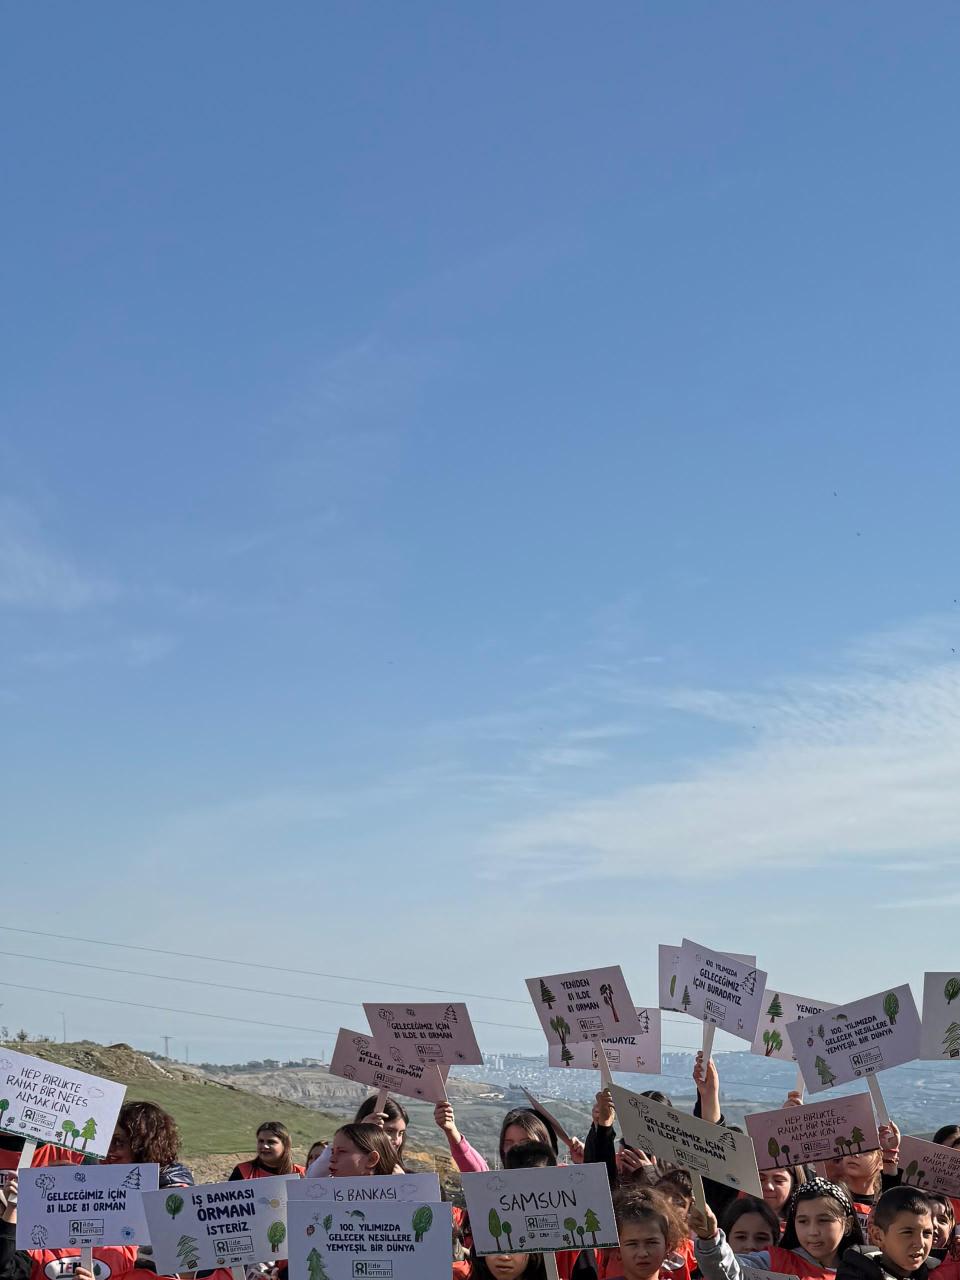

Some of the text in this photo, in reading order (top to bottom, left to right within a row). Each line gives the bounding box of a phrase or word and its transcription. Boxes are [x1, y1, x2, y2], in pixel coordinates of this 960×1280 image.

[716, 963, 737, 977] YILIMIZDA
[700, 968, 741, 992] GELECEĞİMİZ
[576, 1002, 600, 1012] ORMAN
[845, 1015, 877, 1030] YILIMIZDA
[825, 1033, 853, 1046] GELECEK
[826, 1040, 857, 1055] YEMYEŞİL
[871, 1028, 893, 1040] DÜNYA
[21, 1068, 41, 1079] HEP
[396, 1067, 422, 1079] ORMAN
[7, 1075, 37, 1092] RAHAT
[58, 1092, 88, 1107] NEFES
[16, 1092, 49, 1107] ALMAK
[777, 1126, 803, 1136] RAHAT
[821, 1118, 847, 1128] NEFES
[785, 1116, 801, 1125] HEP
[644, 1116, 700, 1143] GELECEĞİMİZ
[792, 1131, 818, 1141] ALMAK
[694, 1143, 726, 1161] ORMAN
[47, 1188, 126, 1202] GELECEĞİMİZ İÇİN
[192, 1189, 254, 1208] İŞ BANKASI
[348, 1188, 396, 1201] BANKASI
[500, 1190, 576, 1211] SAMSUN
[47, 1205, 54, 1213] 81
[94, 1202, 125, 1211] ORMAN
[197, 1203, 255, 1221] ORMANI
[359, 1223, 400, 1231] YILIMIZDA
[329, 1233, 412, 1242] GELECEK NESİLLERE
[326, 1242, 415, 1254] YEMYEŞİL BİR DÜNYA
